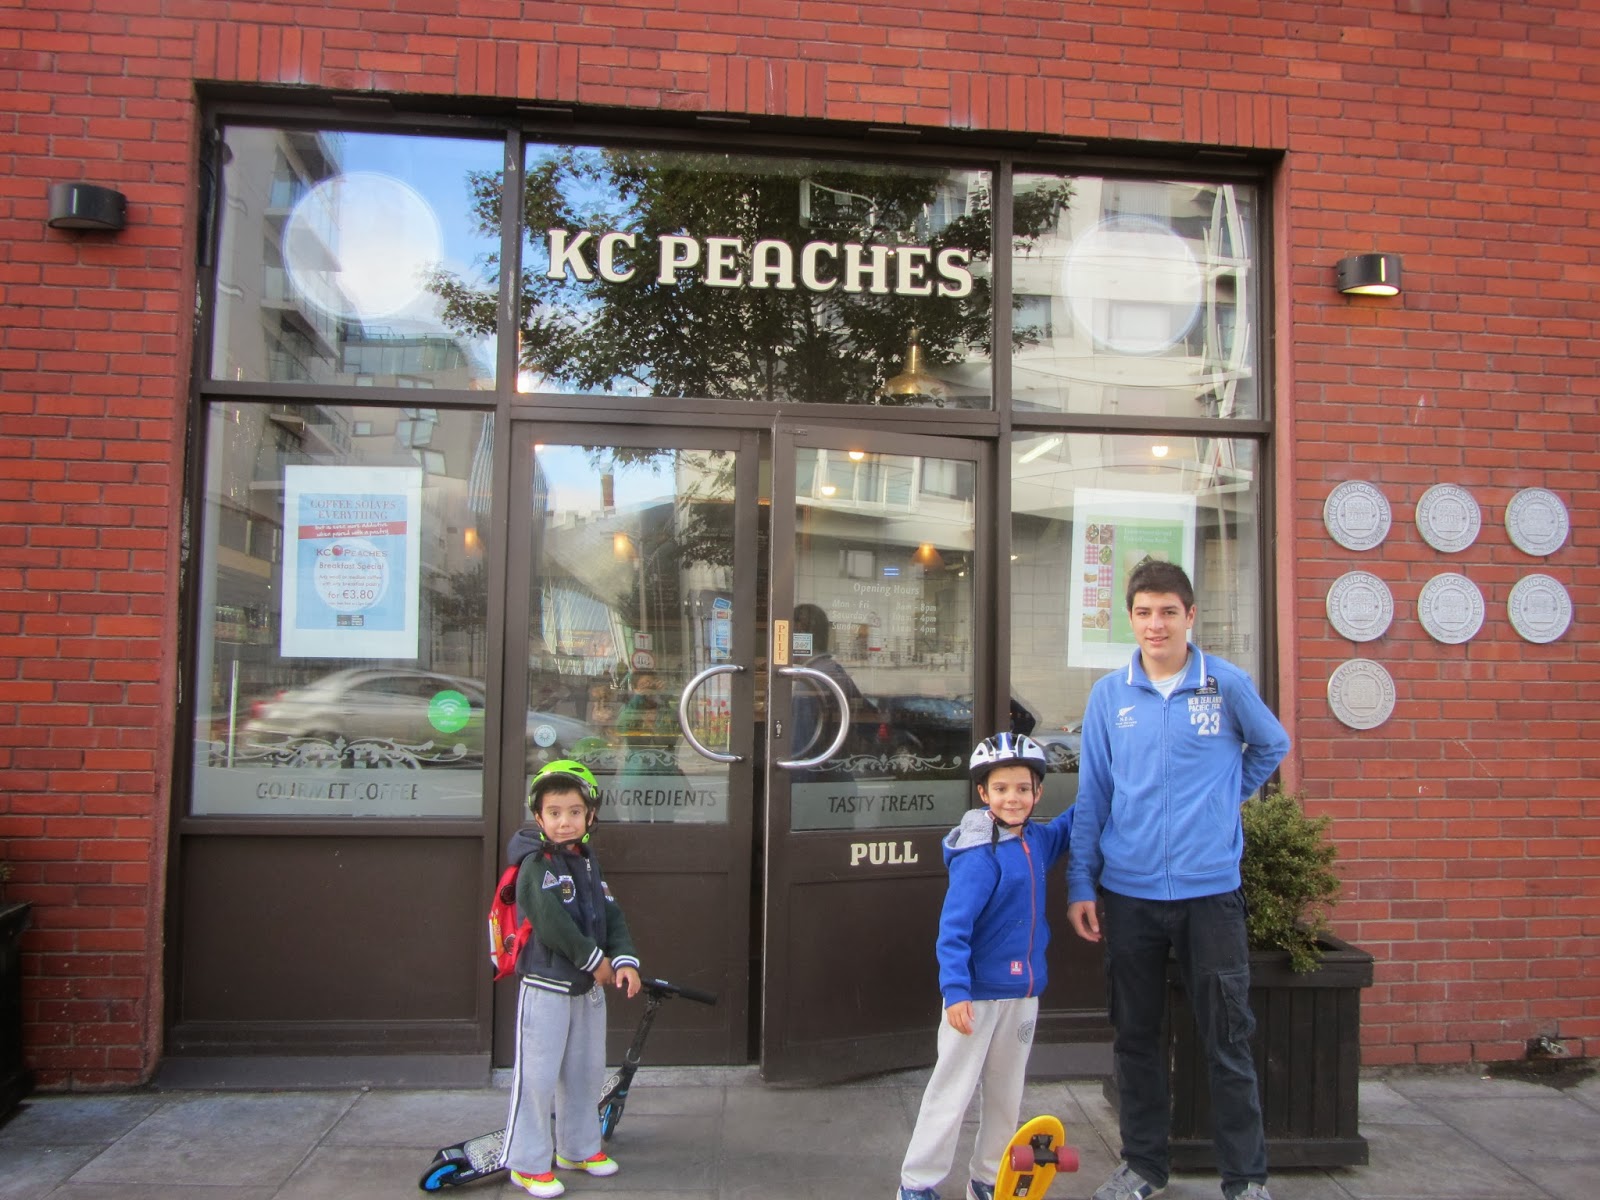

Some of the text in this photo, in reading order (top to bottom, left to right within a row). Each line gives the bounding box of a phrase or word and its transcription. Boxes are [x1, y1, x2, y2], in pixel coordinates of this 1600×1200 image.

[547, 228, 973, 298] KC PEACHES
[310, 499, 396, 510] COFFEE SOLVES
[1328, 484, 1389, 522] THE BRIDGESTONE
[318, 509, 388, 520] EVERYTHING
[316, 548, 332, 557] KC
[319, 561, 384, 571] Breakfast Special
[328, 589, 374, 600] for €3.80
[853, 582, 920, 597] Opening Hours
[1422, 577, 1482, 615] THE BRIDGESTONE
[832, 599, 850, 608] Mon
[858, 599, 870, 609] Fri
[920, 602, 937, 612] 8pm
[831, 611, 867, 622] Saturday
[920, 613, 937, 624] 4pm
[831, 621, 861, 633] Sunday
[920, 625, 937, 635] 4pm
[777, 624, 787, 661] PULL
[600, 789, 717, 808] INGREDIENTS
[828, 794, 935, 813] TASTY TREATS
[850, 841, 919, 866] PULL
